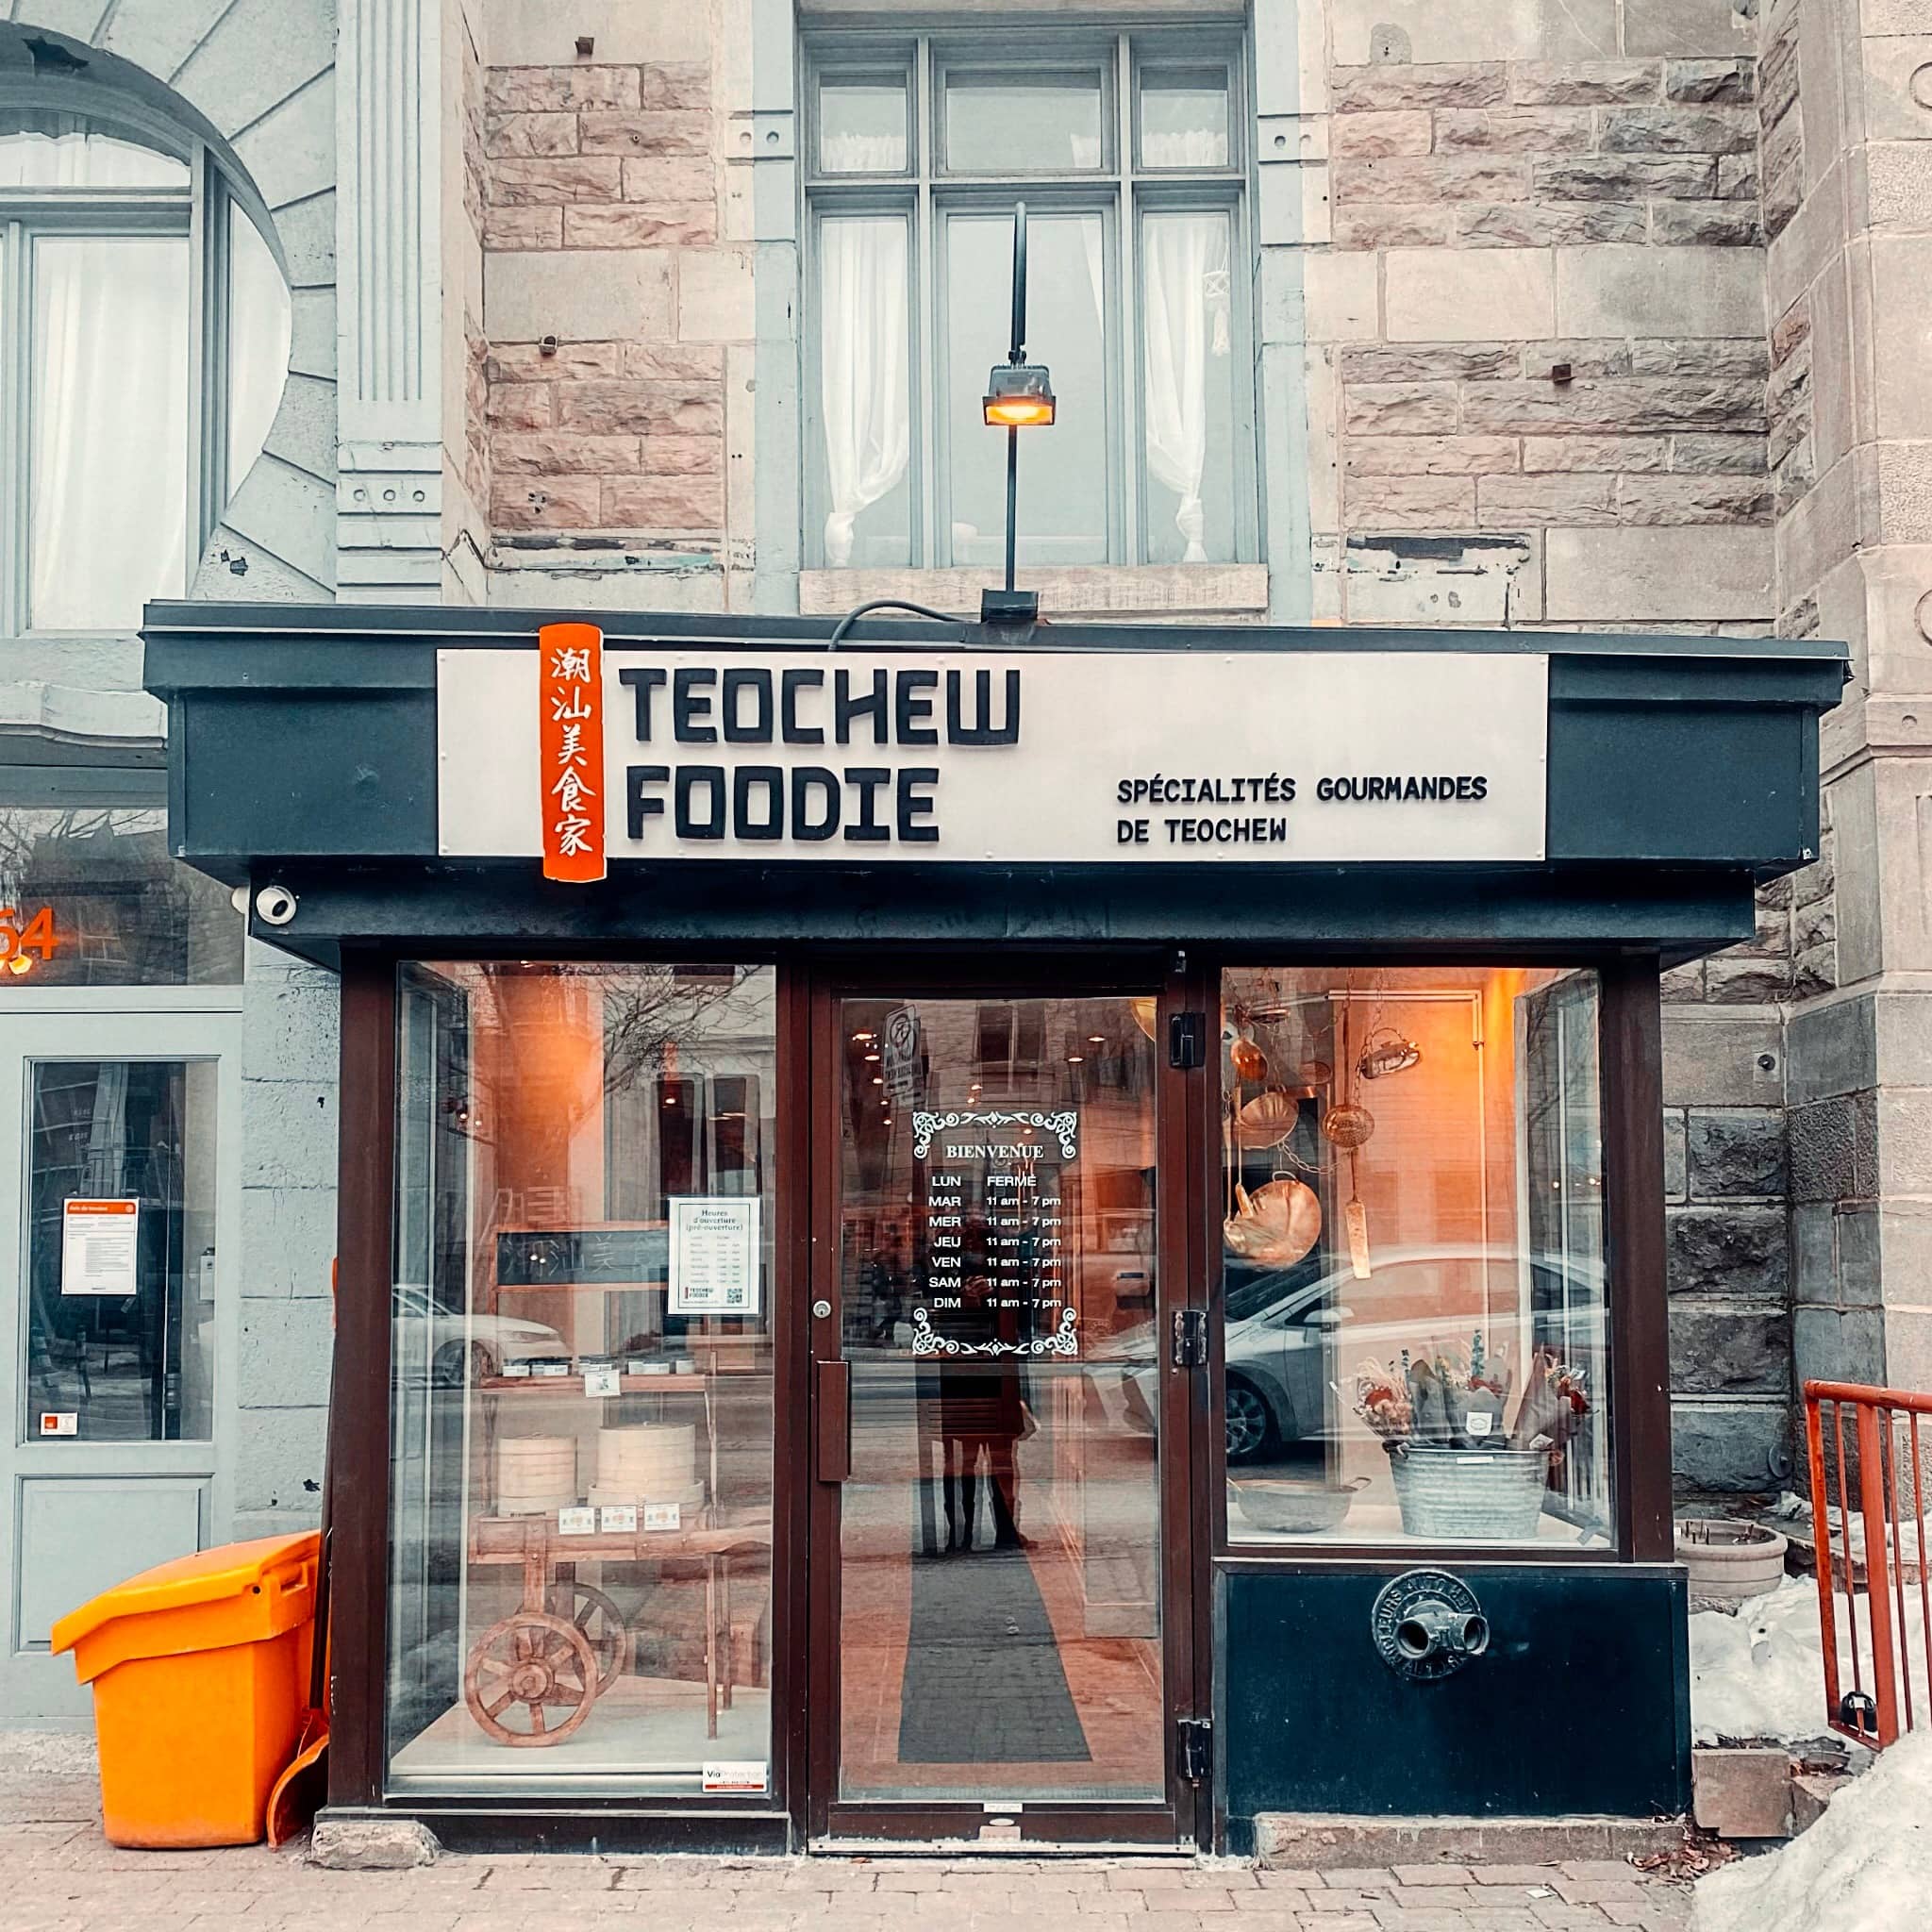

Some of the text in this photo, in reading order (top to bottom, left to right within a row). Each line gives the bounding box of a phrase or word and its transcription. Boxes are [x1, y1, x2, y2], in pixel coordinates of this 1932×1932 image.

[618, 668, 1021, 746] TEOCHEW
[550, 647, 596, 857] 潮汕美食家
[1117, 772, 1488, 804] SPÉCIALITÉS GOURMANDES
[625, 765, 940, 842] FOODIE
[1117, 817, 1287, 843] DE TEOCHEW
[945, 1144, 1044, 1159] BIENVENUE
[932, 1175, 961, 1187] LUN
[928, 1195, 961, 1207] MAR
[986, 1196, 997, 1206] 11
[1000, 1197, 1020, 1206] am
[1031, 1196, 1040, 1206] 7
[1041, 1197, 1061, 1208] pm
[928, 1216, 961, 1227] MER
[986, 1217, 997, 1226] 11
[1000, 1218, 1020, 1226] am
[1031, 1217, 1040, 1226] 7
[1041, 1218, 1061, 1228] pm
[933, 1236, 961, 1247] JEU
[986, 1237, 997, 1246] 11
[1000, 1238, 1020, 1246] am
[1031, 1237, 1040, 1246] 7
[1041, 1238, 1061, 1248] pm
[931, 1257, 961, 1268] VEN
[986, 1257, 997, 1267] 11
[1000, 1258, 1020, 1267] am
[1031, 1257, 1040, 1267] 7
[1041, 1258, 1061, 1269] pm
[928, 1276, 961, 1288] SAM
[986, 1277, 997, 1287] 11
[1000, 1278, 1020, 1287] am
[1031, 1277, 1040, 1287] 7
[1041, 1278, 1061, 1289] pm
[933, 1297, 961, 1308] DIM
[986, 1298, 997, 1307] 11
[1000, 1299, 1020, 1307] am
[1031, 1298, 1040, 1307] 7
[1041, 1299, 1061, 1309] pm
